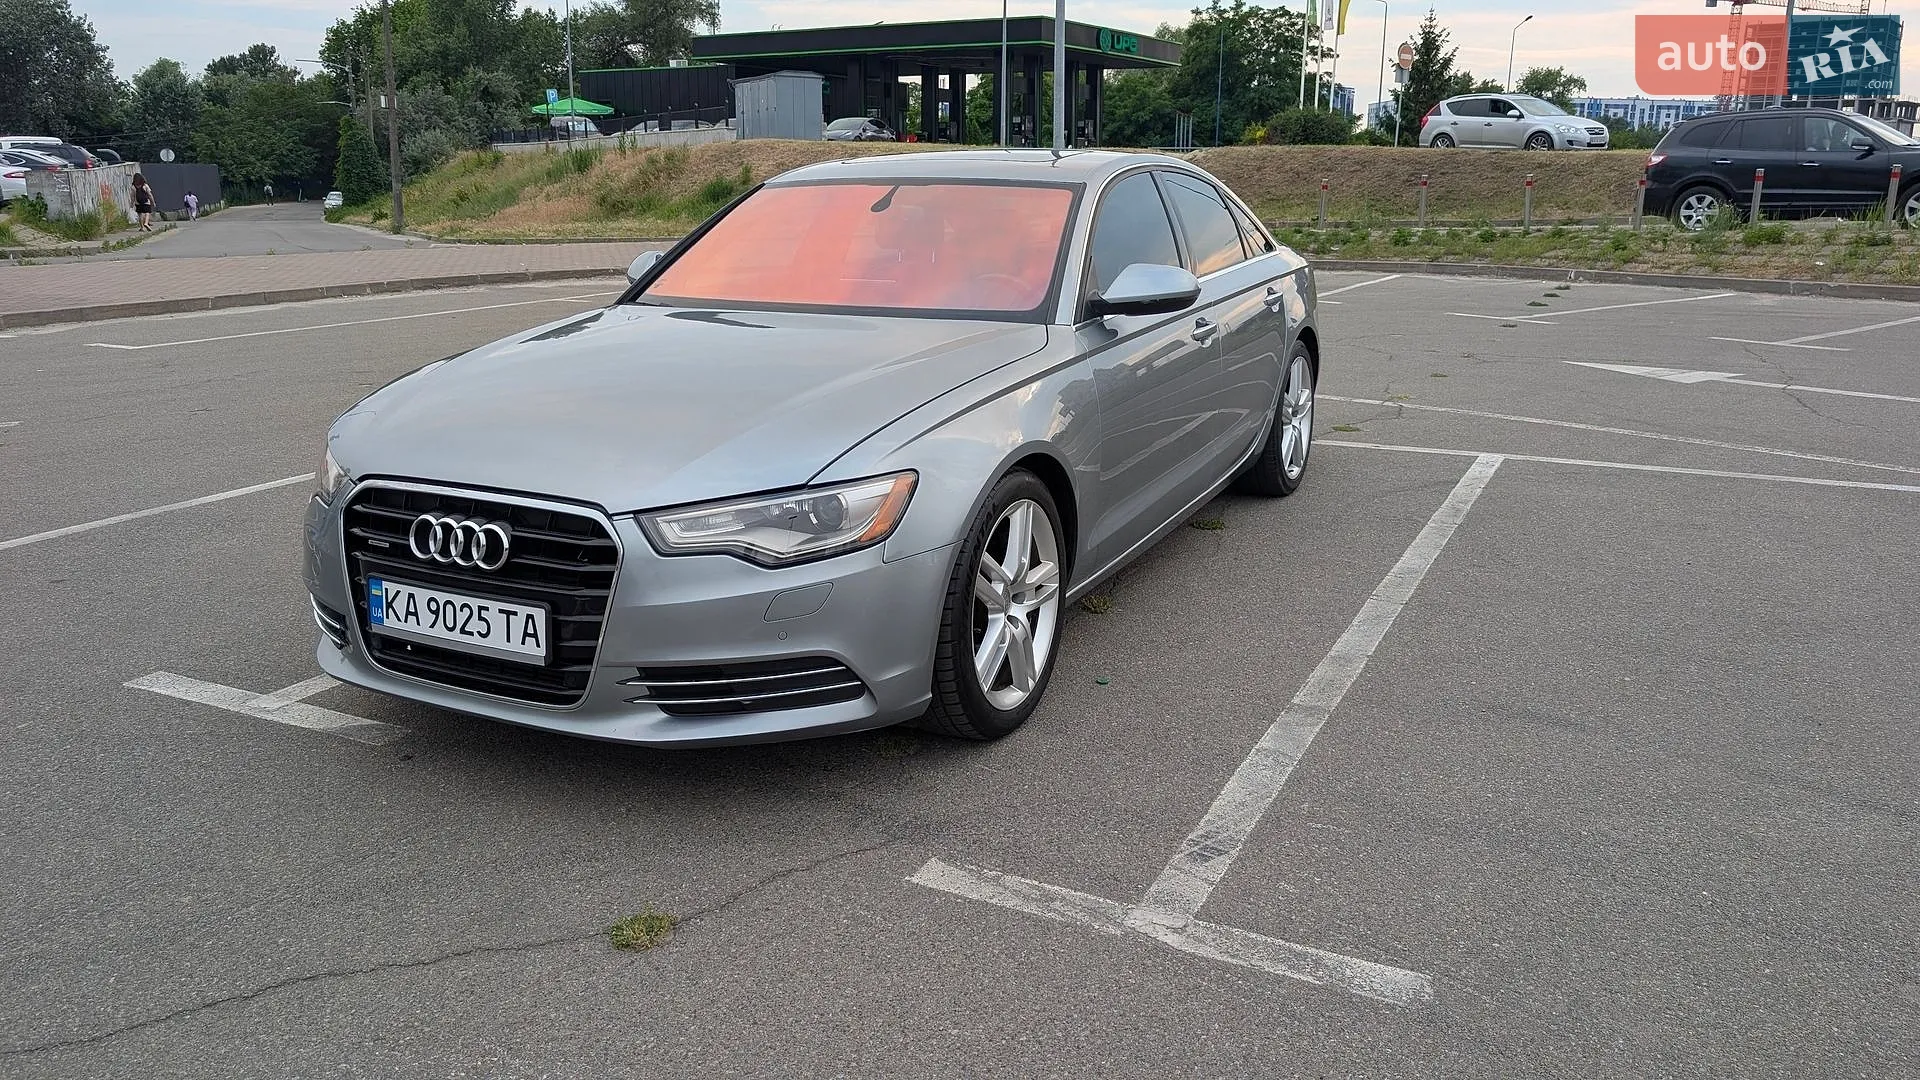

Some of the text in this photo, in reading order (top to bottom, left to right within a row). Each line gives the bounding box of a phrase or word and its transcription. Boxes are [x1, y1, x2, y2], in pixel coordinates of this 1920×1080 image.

[372, 607, 383, 618] UA
[384, 587, 541, 649] KA 9025 TA
